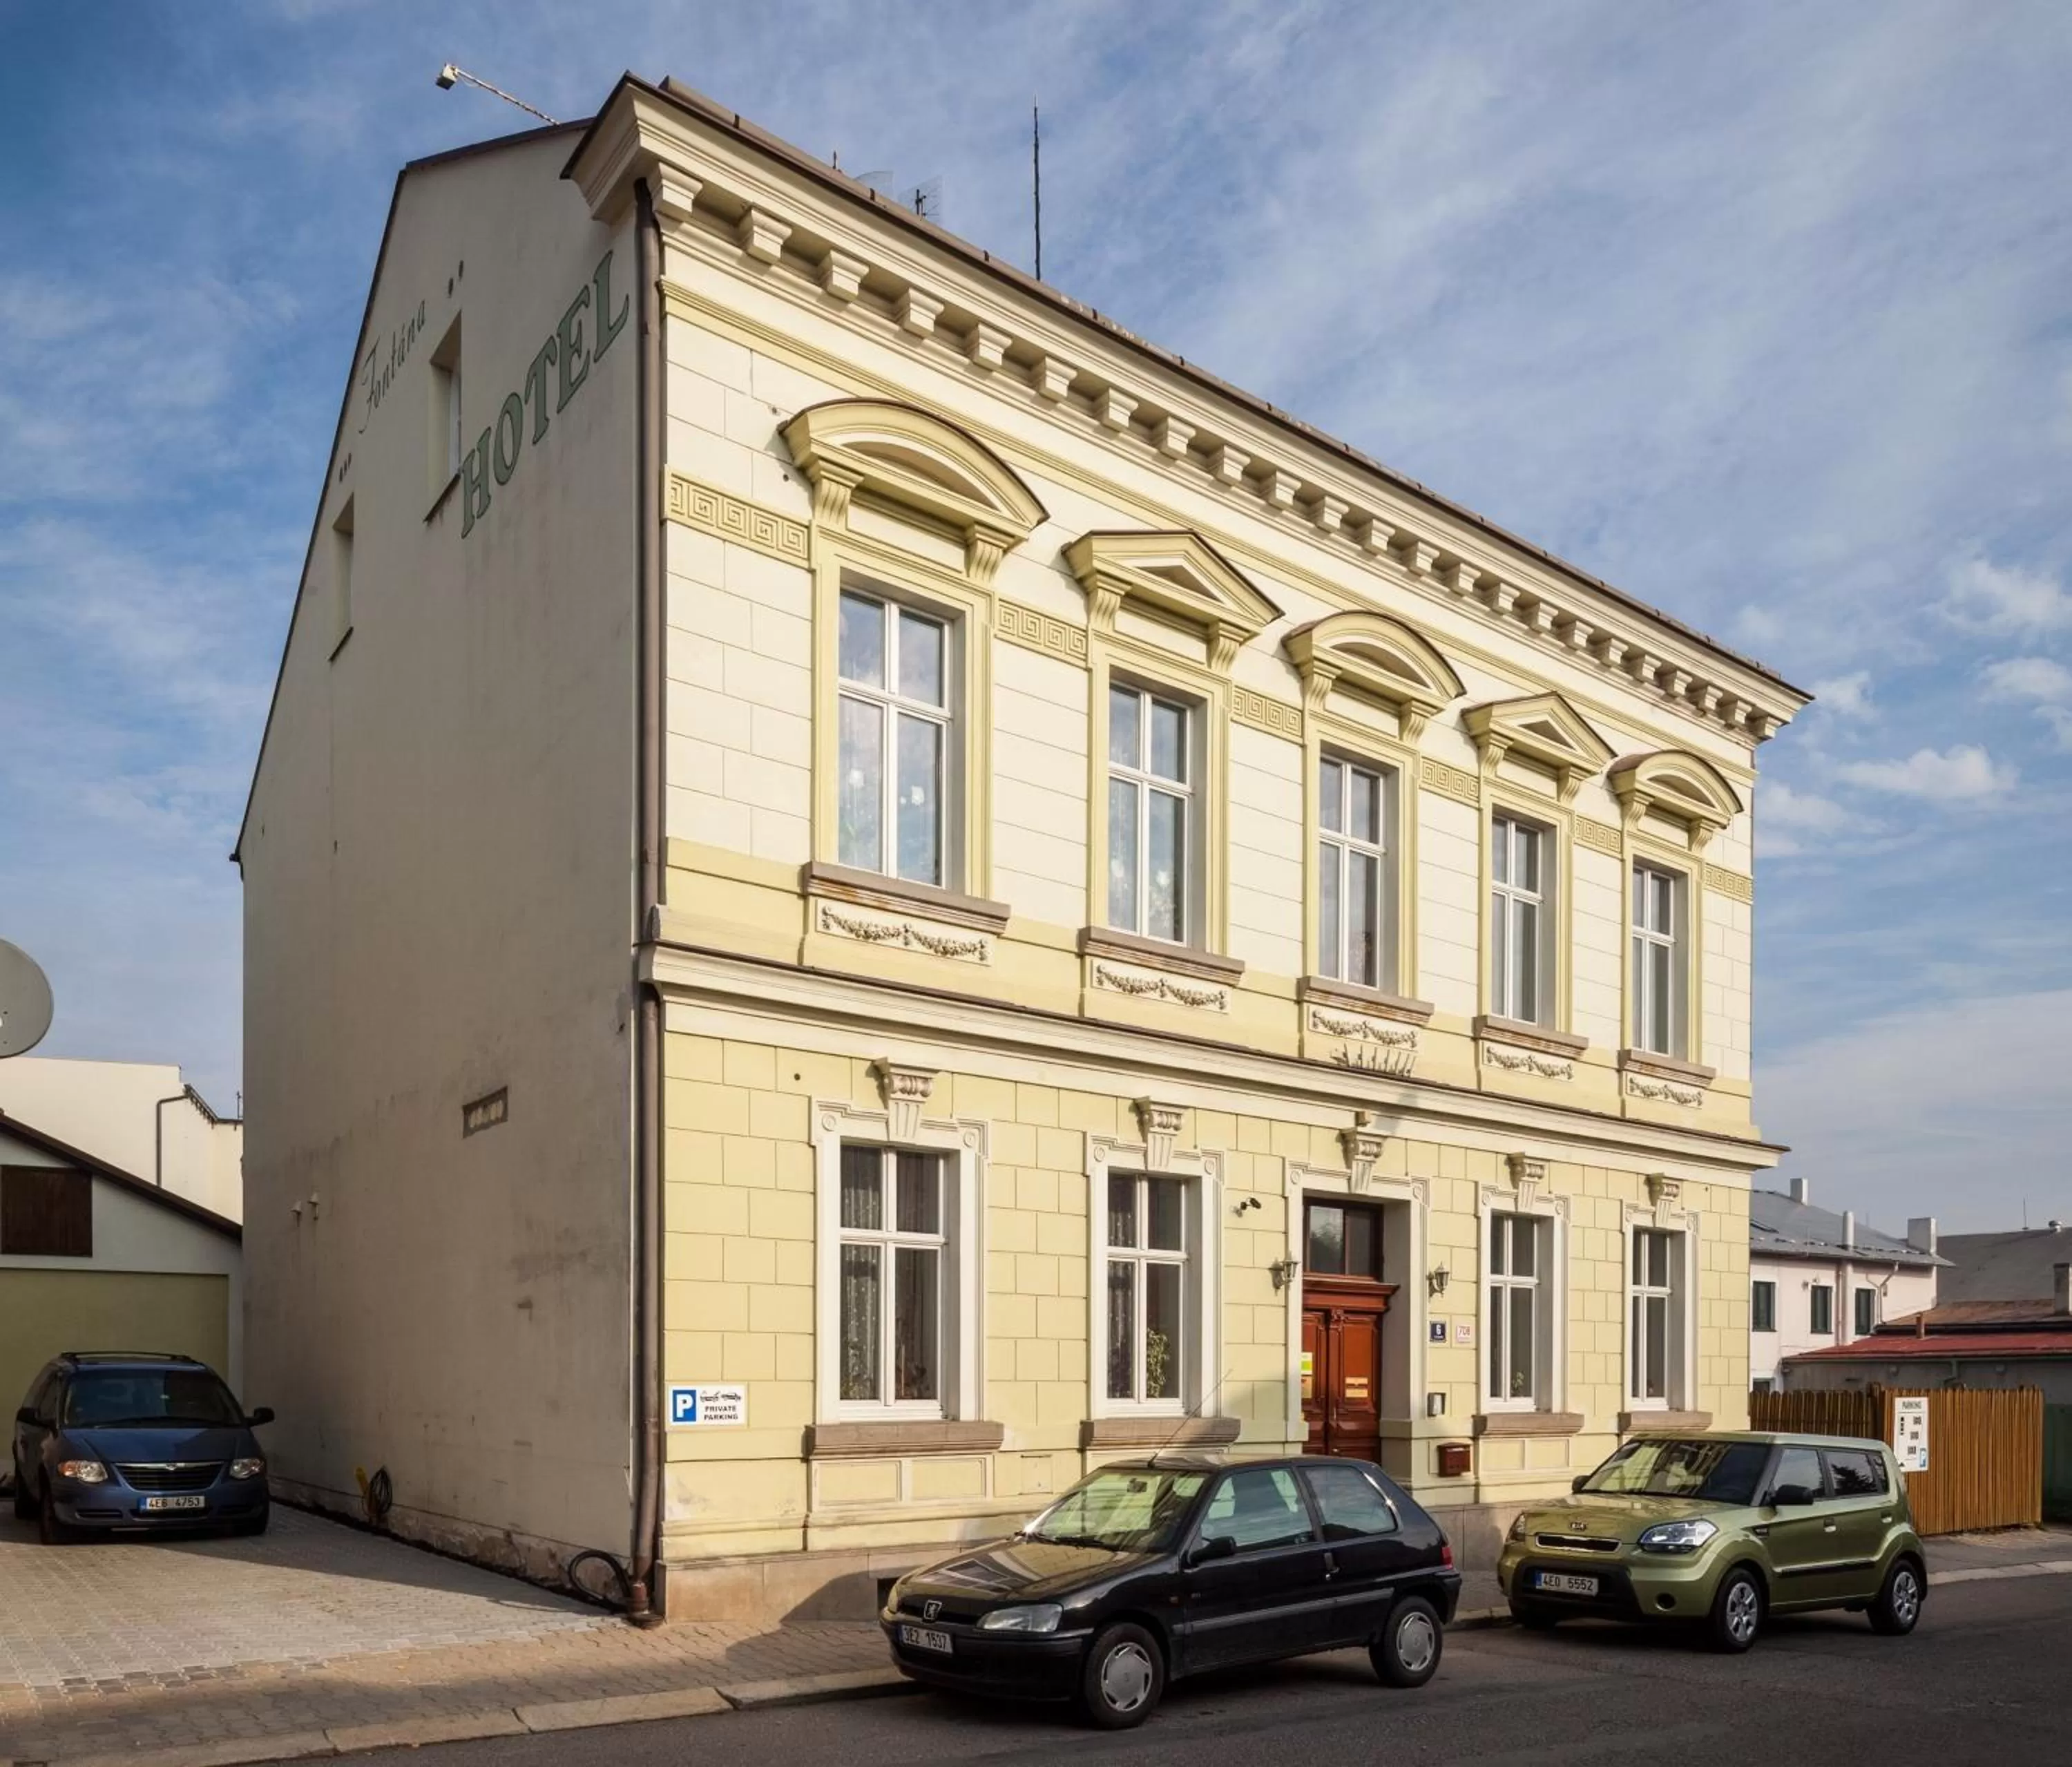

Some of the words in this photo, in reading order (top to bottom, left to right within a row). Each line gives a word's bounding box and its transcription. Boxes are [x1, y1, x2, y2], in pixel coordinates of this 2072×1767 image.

[461, 249, 629, 539] HOTEL
[1436, 1324, 1441, 1335] 6
[676, 1393, 693, 1418] P
[1568, 1578, 1593, 1592] 5552
